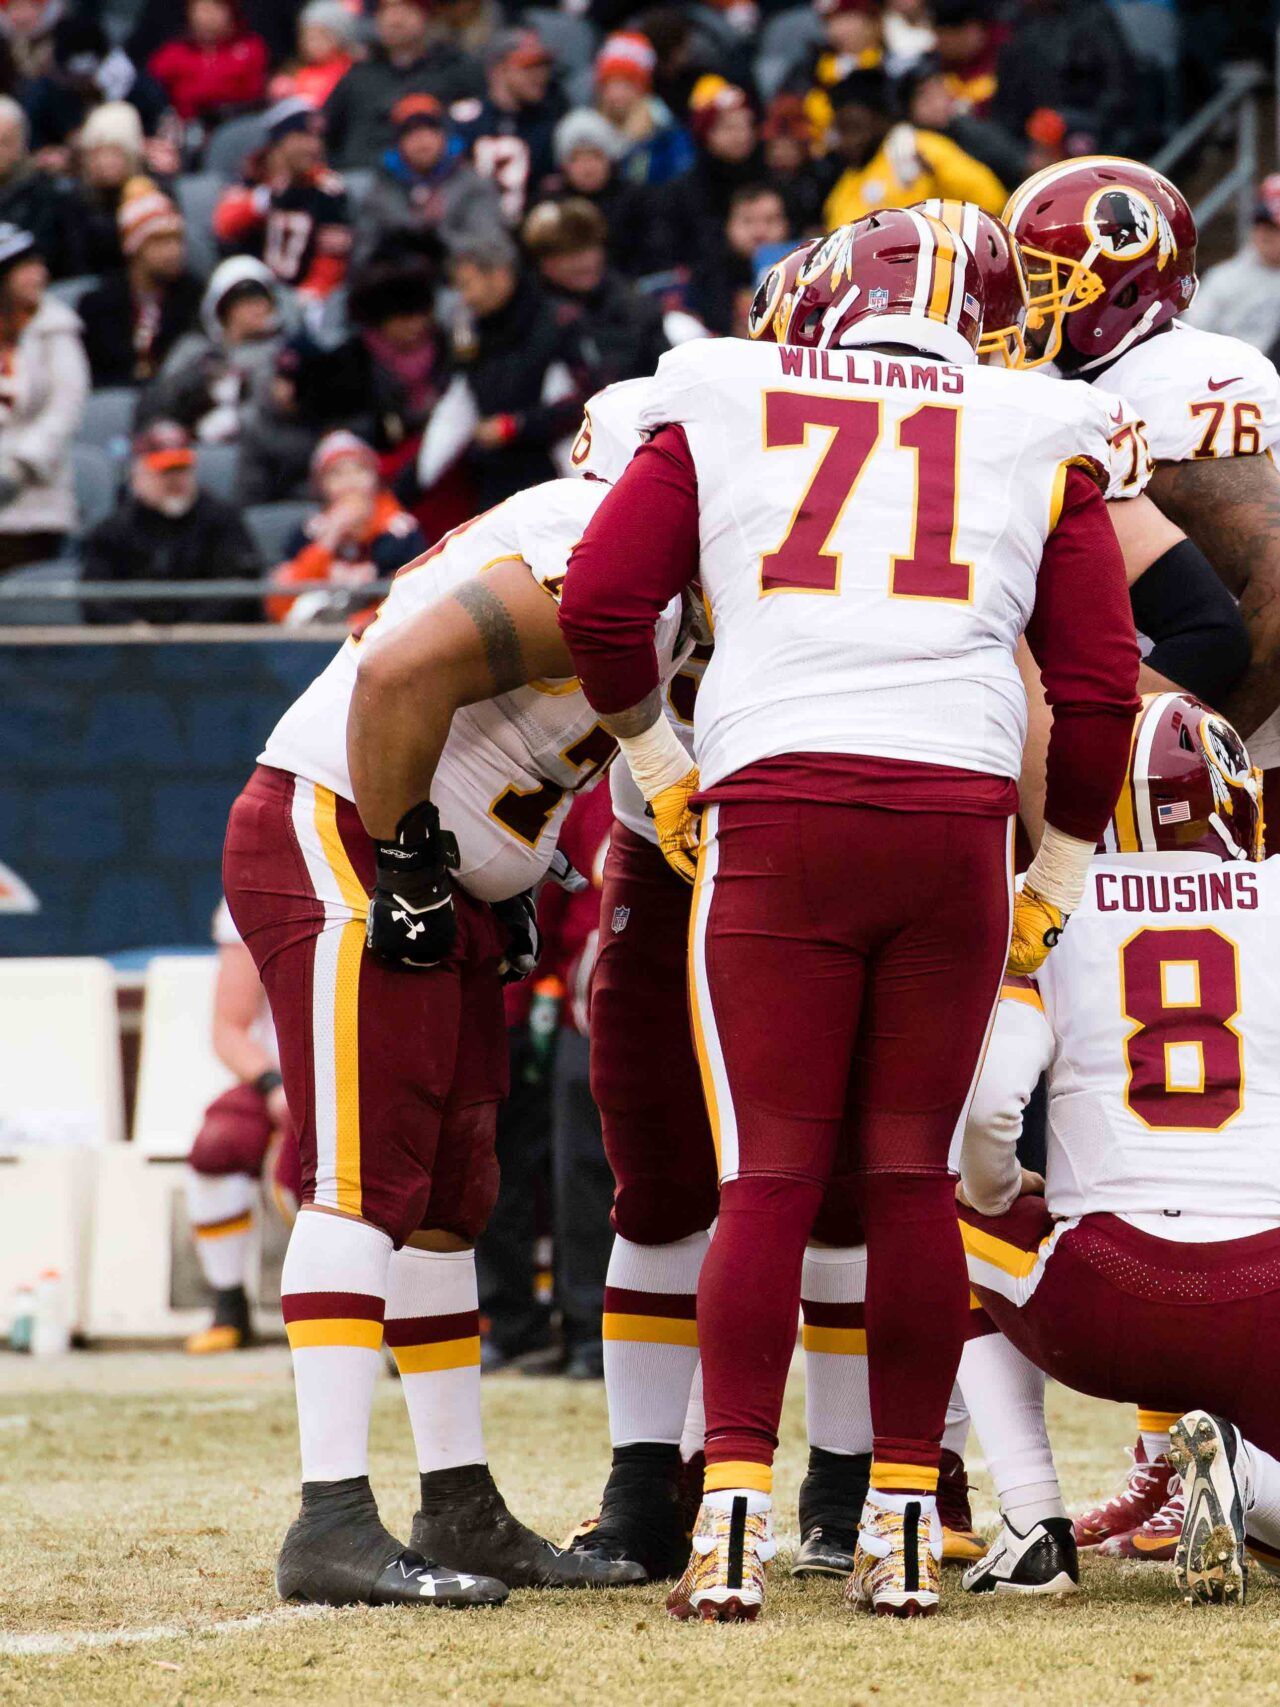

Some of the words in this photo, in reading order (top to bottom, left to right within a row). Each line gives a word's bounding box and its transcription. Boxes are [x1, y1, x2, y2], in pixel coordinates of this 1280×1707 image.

[778, 345, 965, 395] WILLIAMS
[1188, 400, 1263, 458] 76
[760, 388, 975, 605] 71
[1095, 871, 1259, 913] COUSINS
[1118, 924, 1245, 1132] 8
